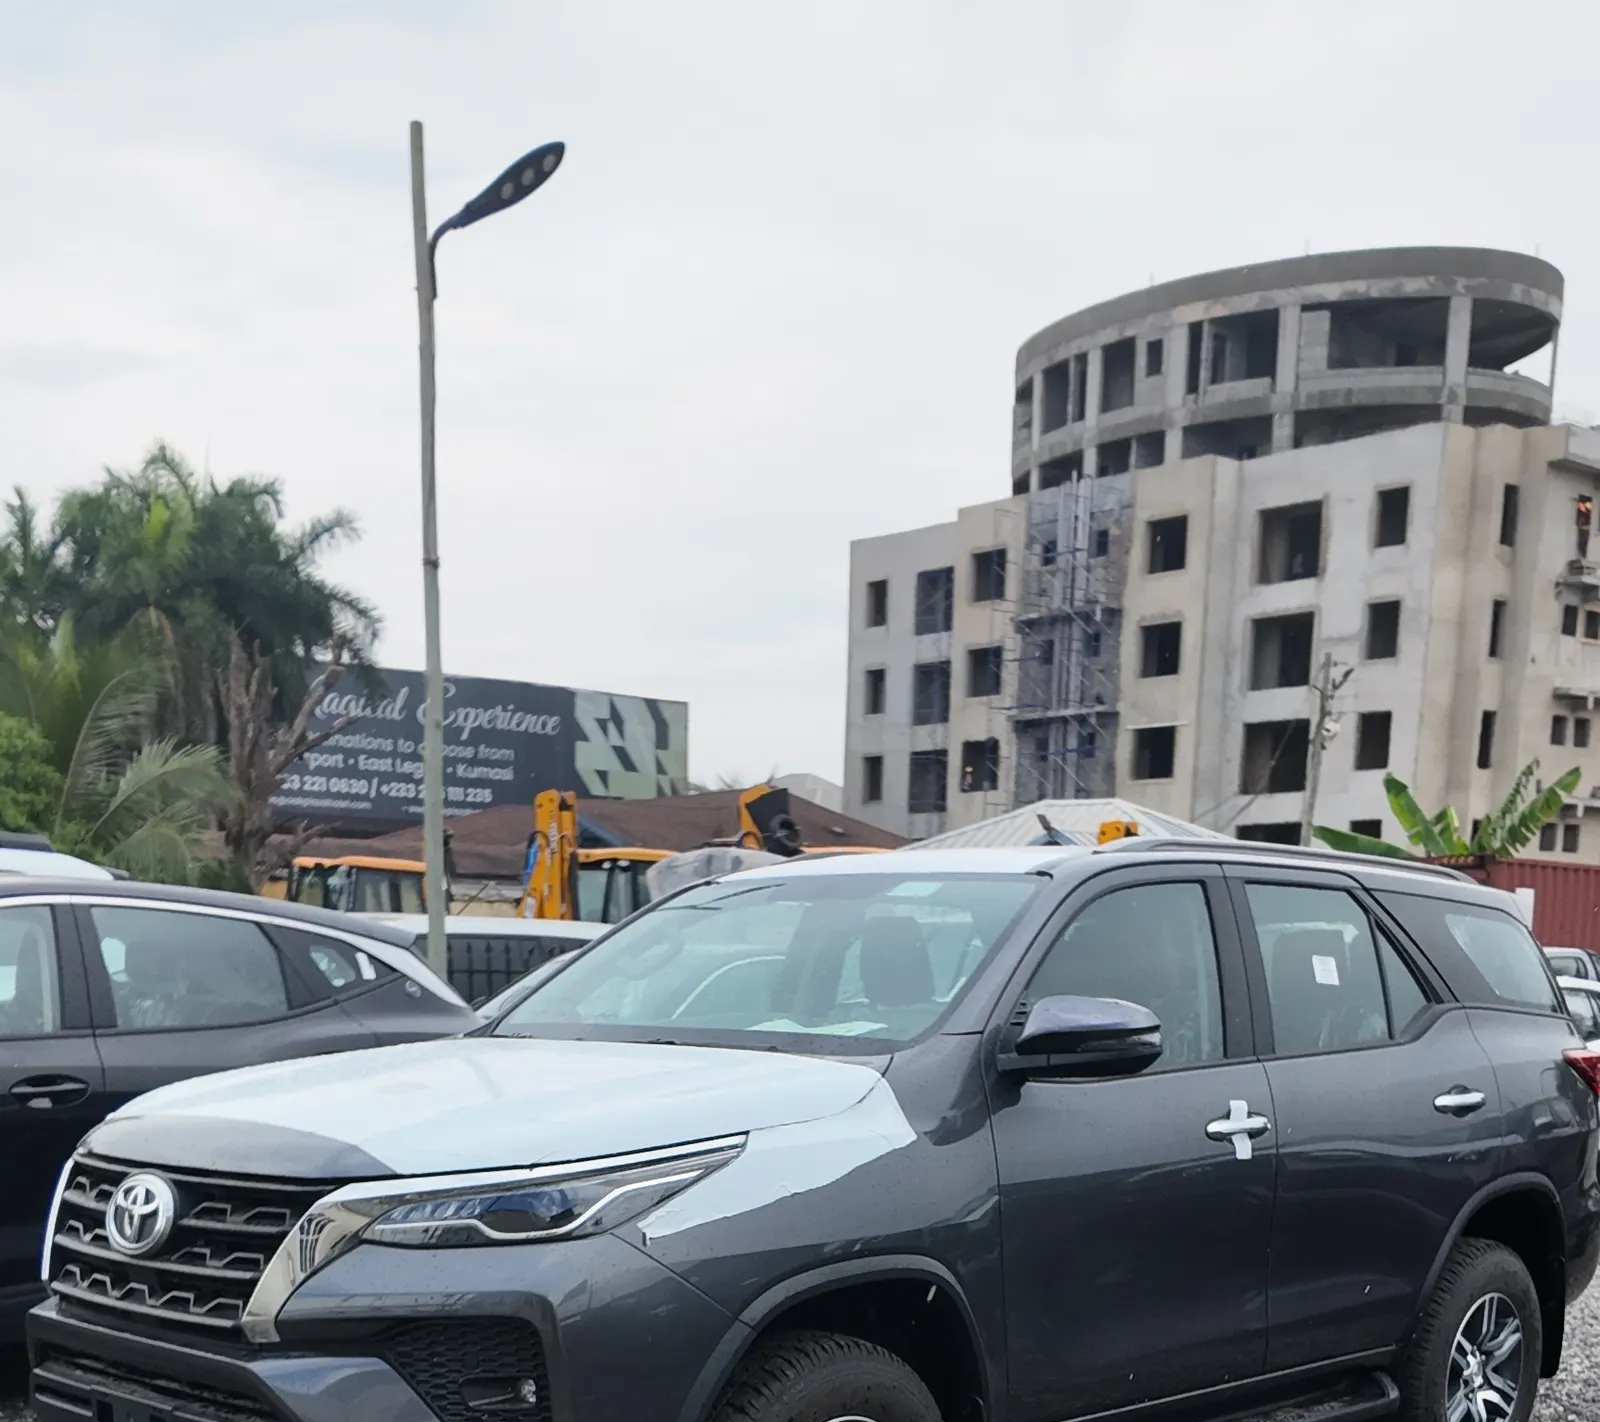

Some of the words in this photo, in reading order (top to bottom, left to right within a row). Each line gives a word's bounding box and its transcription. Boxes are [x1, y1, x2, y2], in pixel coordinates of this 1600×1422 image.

[477, 743, 515, 761] from
[358, 754, 393, 772] East
[455, 762, 514, 781] Kumasi
